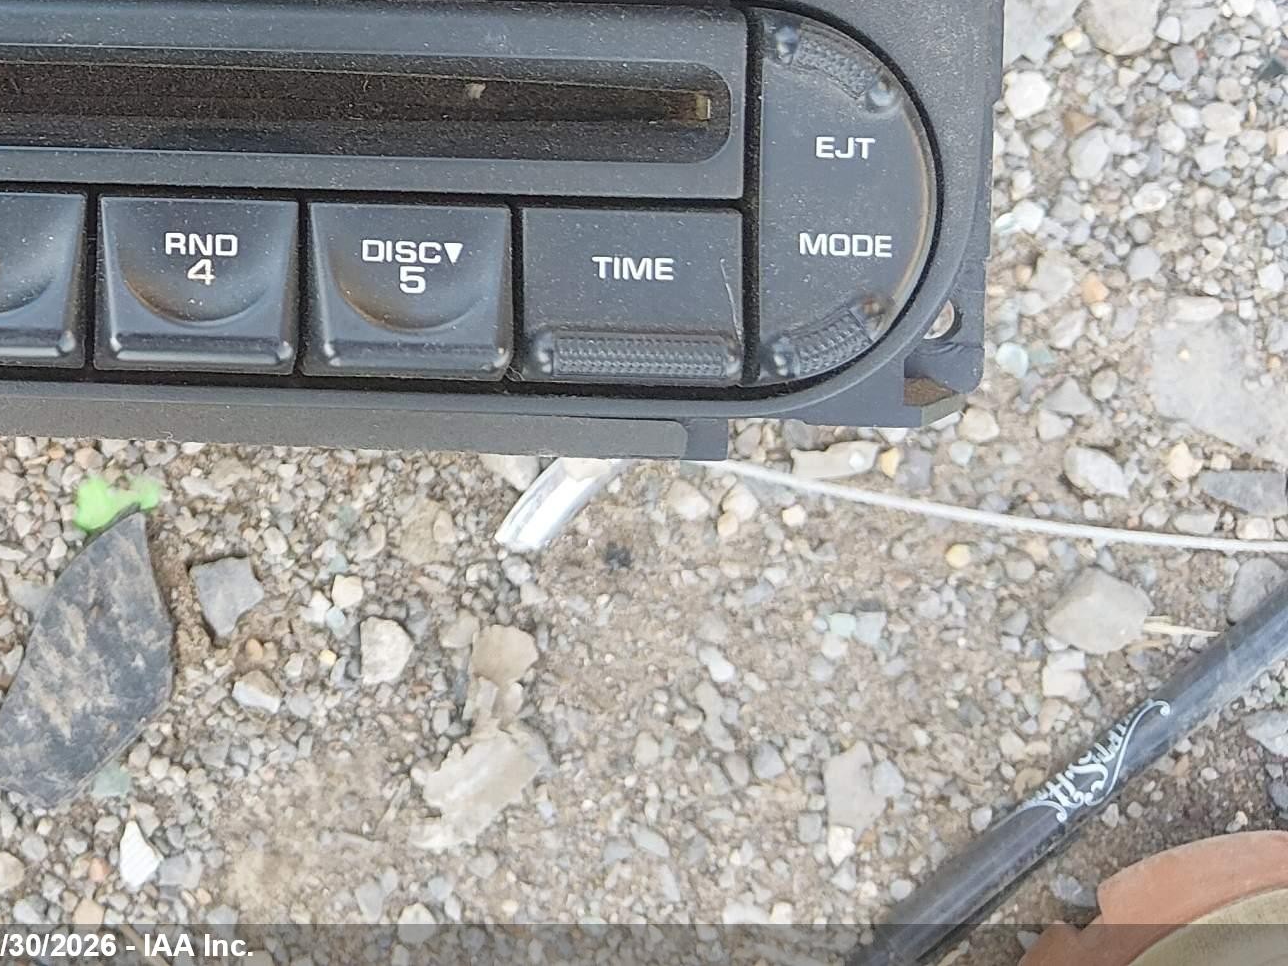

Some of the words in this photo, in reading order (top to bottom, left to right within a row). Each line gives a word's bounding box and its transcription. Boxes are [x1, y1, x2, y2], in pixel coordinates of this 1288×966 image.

[815, 136, 876, 159] EJT
[164, 231, 239, 258] RND
[362, 239, 442, 264] DISC
[799, 232, 892, 258] MODE
[187, 258, 215, 286] 4
[399, 265, 426, 294] 5
[591, 256, 674, 281] TIME
